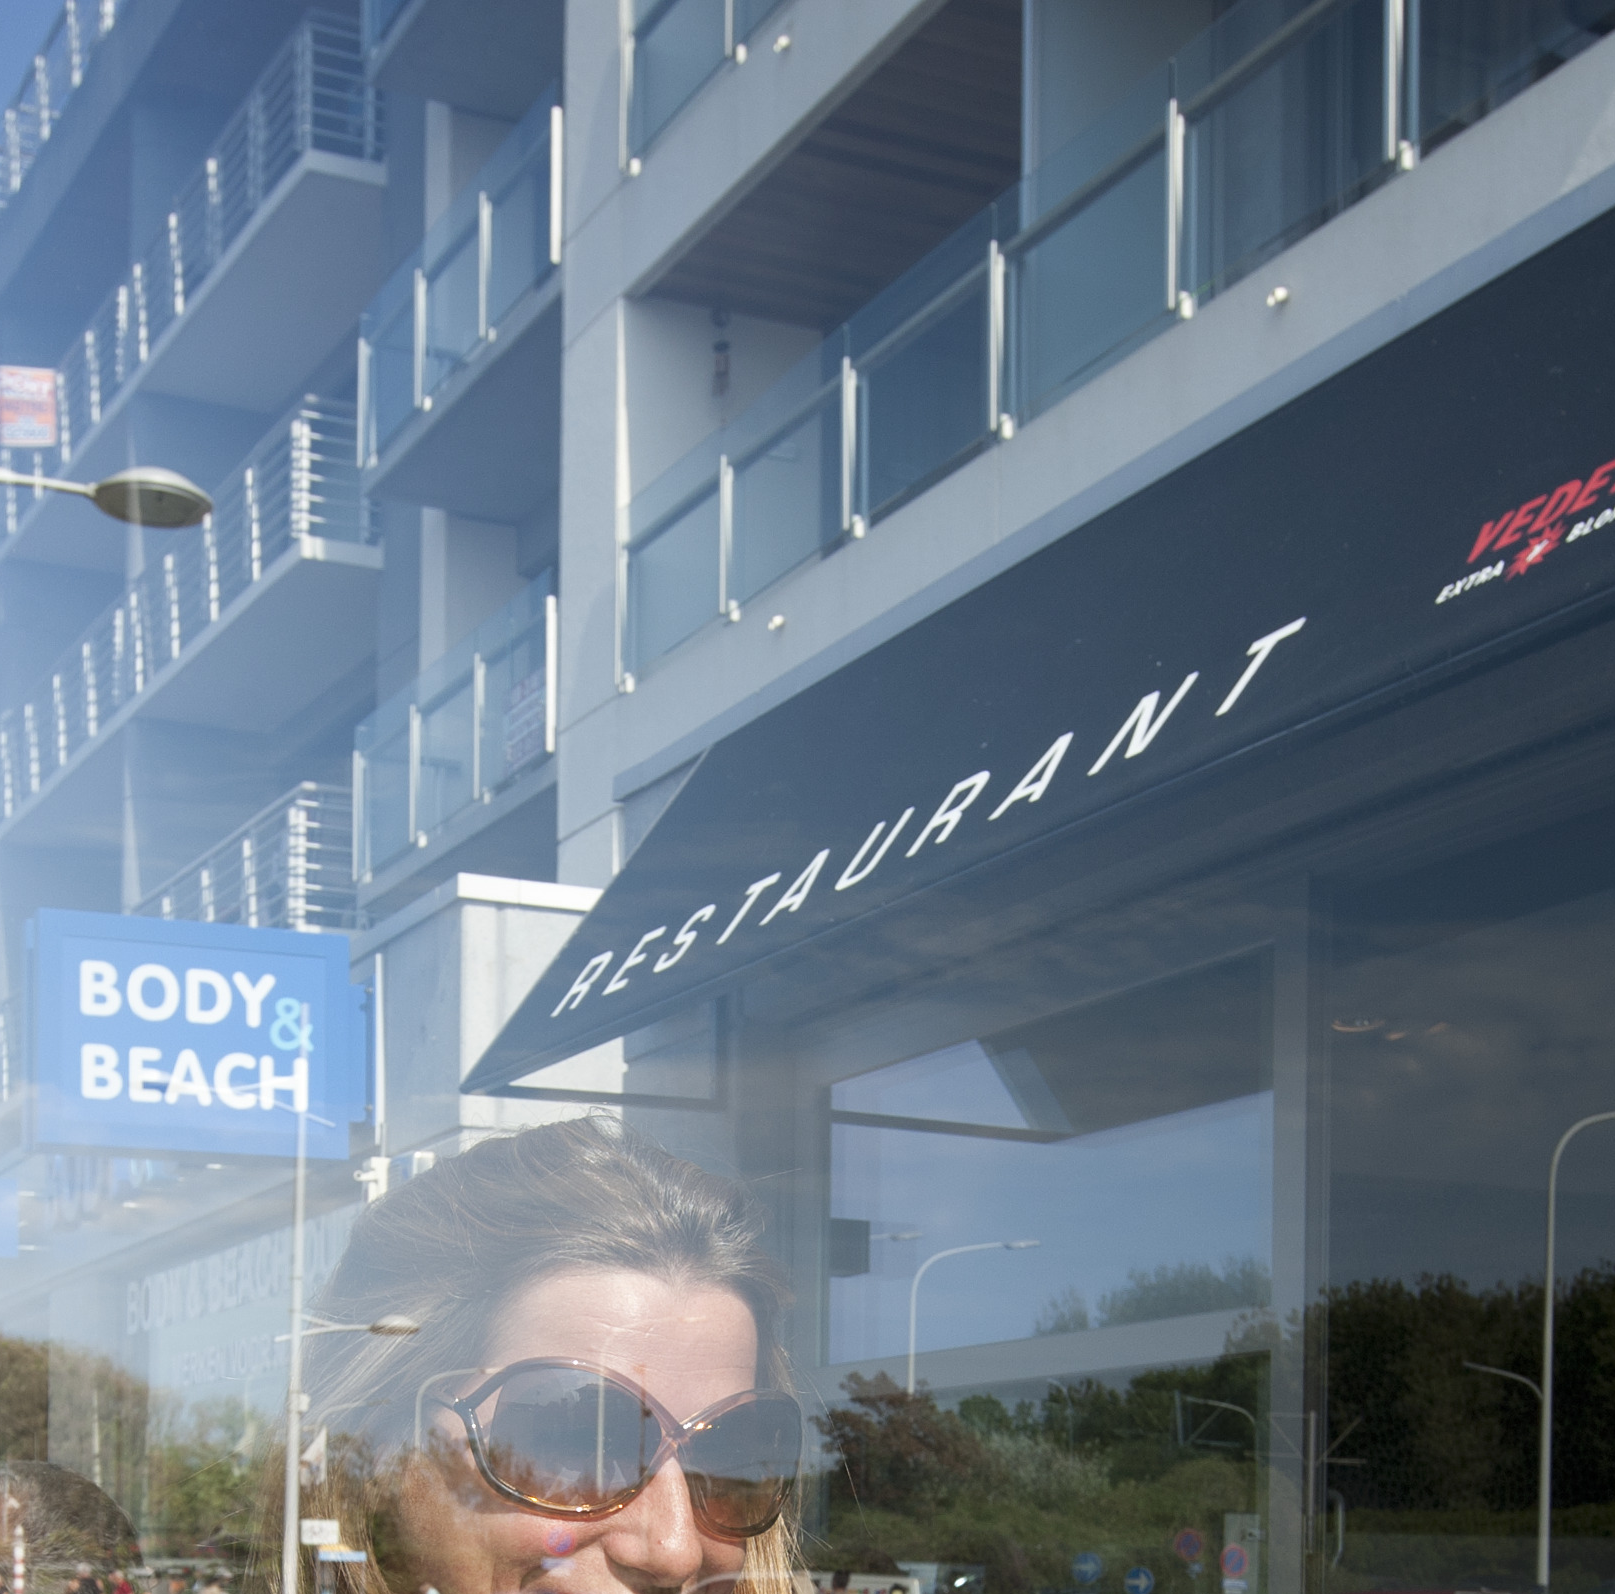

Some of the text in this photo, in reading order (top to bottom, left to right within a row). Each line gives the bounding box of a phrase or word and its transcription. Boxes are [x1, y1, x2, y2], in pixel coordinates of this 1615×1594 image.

[1435, 560, 1505, 604] EXTRA
[550, 617, 1307, 1018] RESTAURANT
[78, 959, 314, 1051] BODY &
[80, 1043, 309, 1112] BEACH
